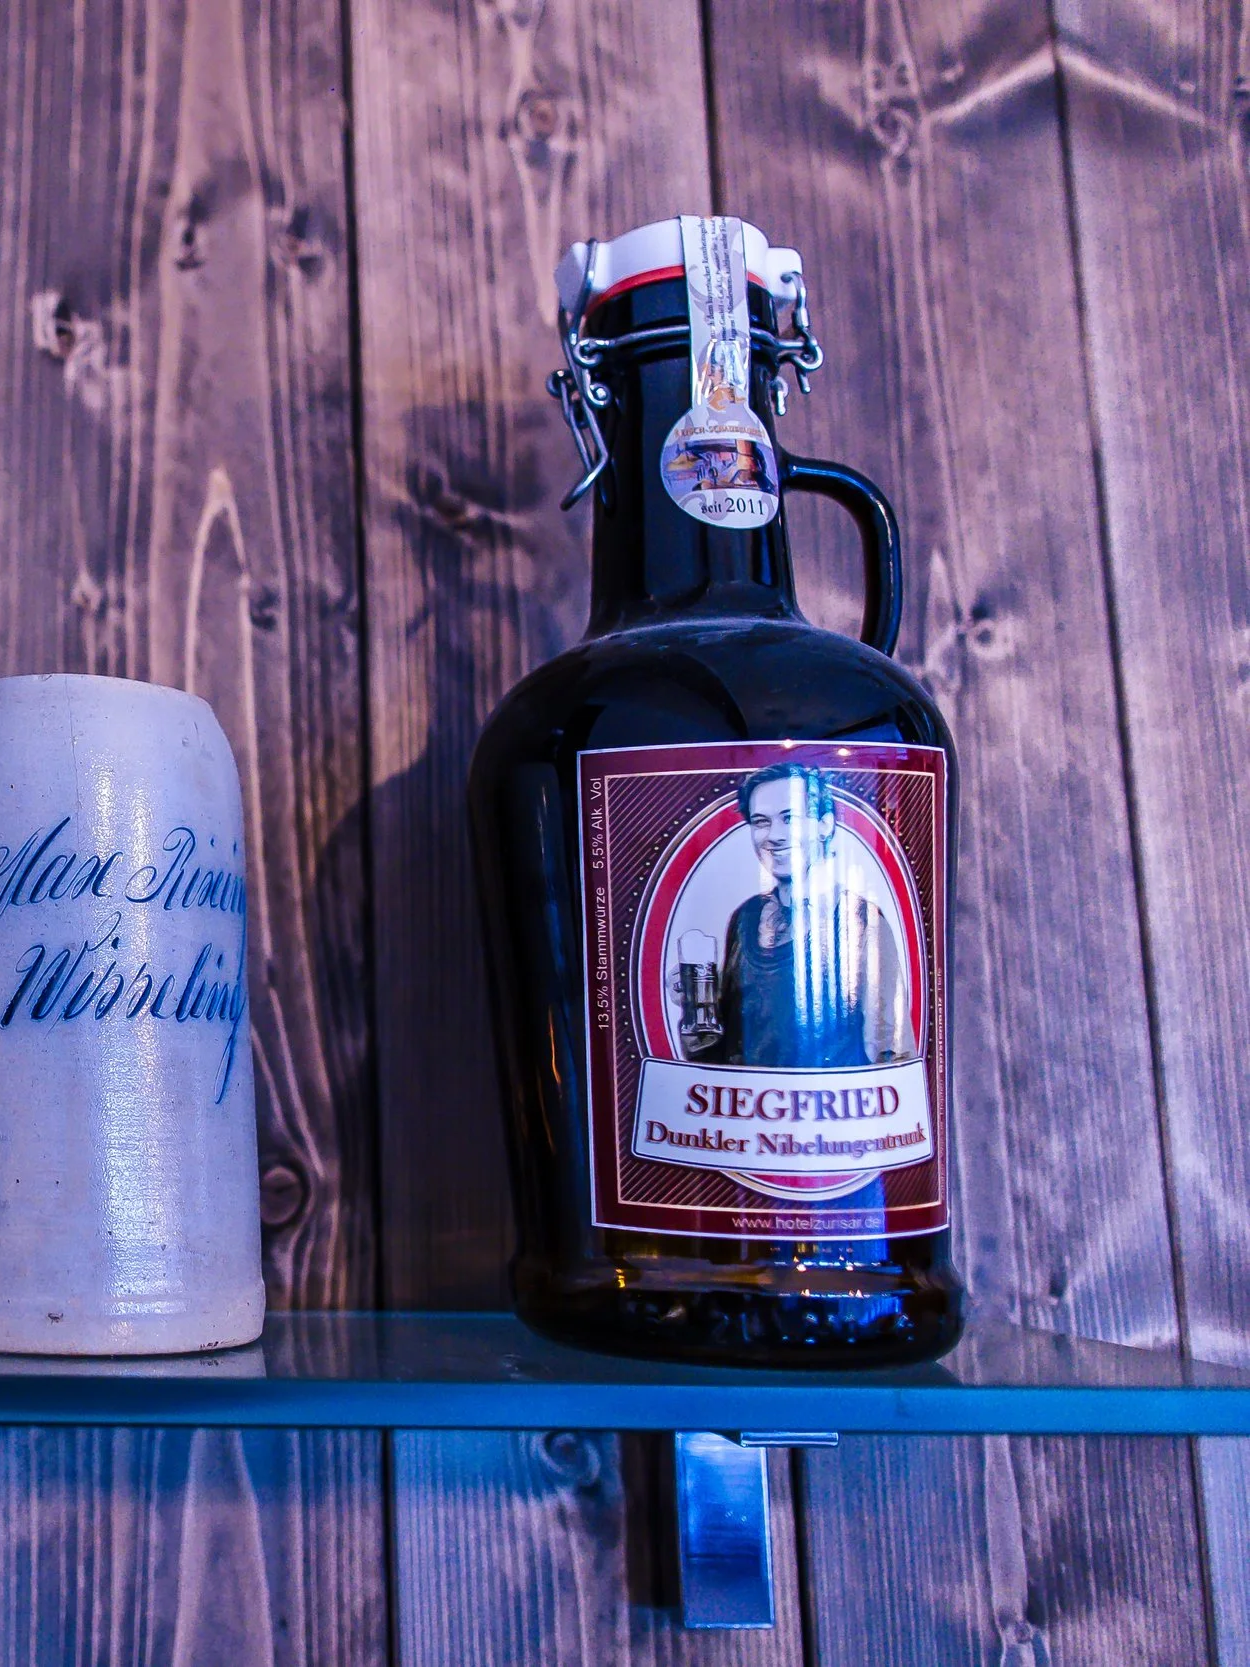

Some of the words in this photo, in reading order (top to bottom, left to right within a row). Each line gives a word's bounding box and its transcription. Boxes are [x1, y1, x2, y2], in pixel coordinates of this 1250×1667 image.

[701, 501, 723, 514] seit
[725, 497, 764, 515] 2011
[592, 833, 605, 869] 5,5%
[595, 887, 608, 981] Stammwürze
[597, 985, 610, 1030] 13,5%
[686, 1083, 900, 1122] SIEGFRIED
[646, 1120, 750, 1153] Dunkler
[756, 1122, 928, 1159] Nibelungentrunk
